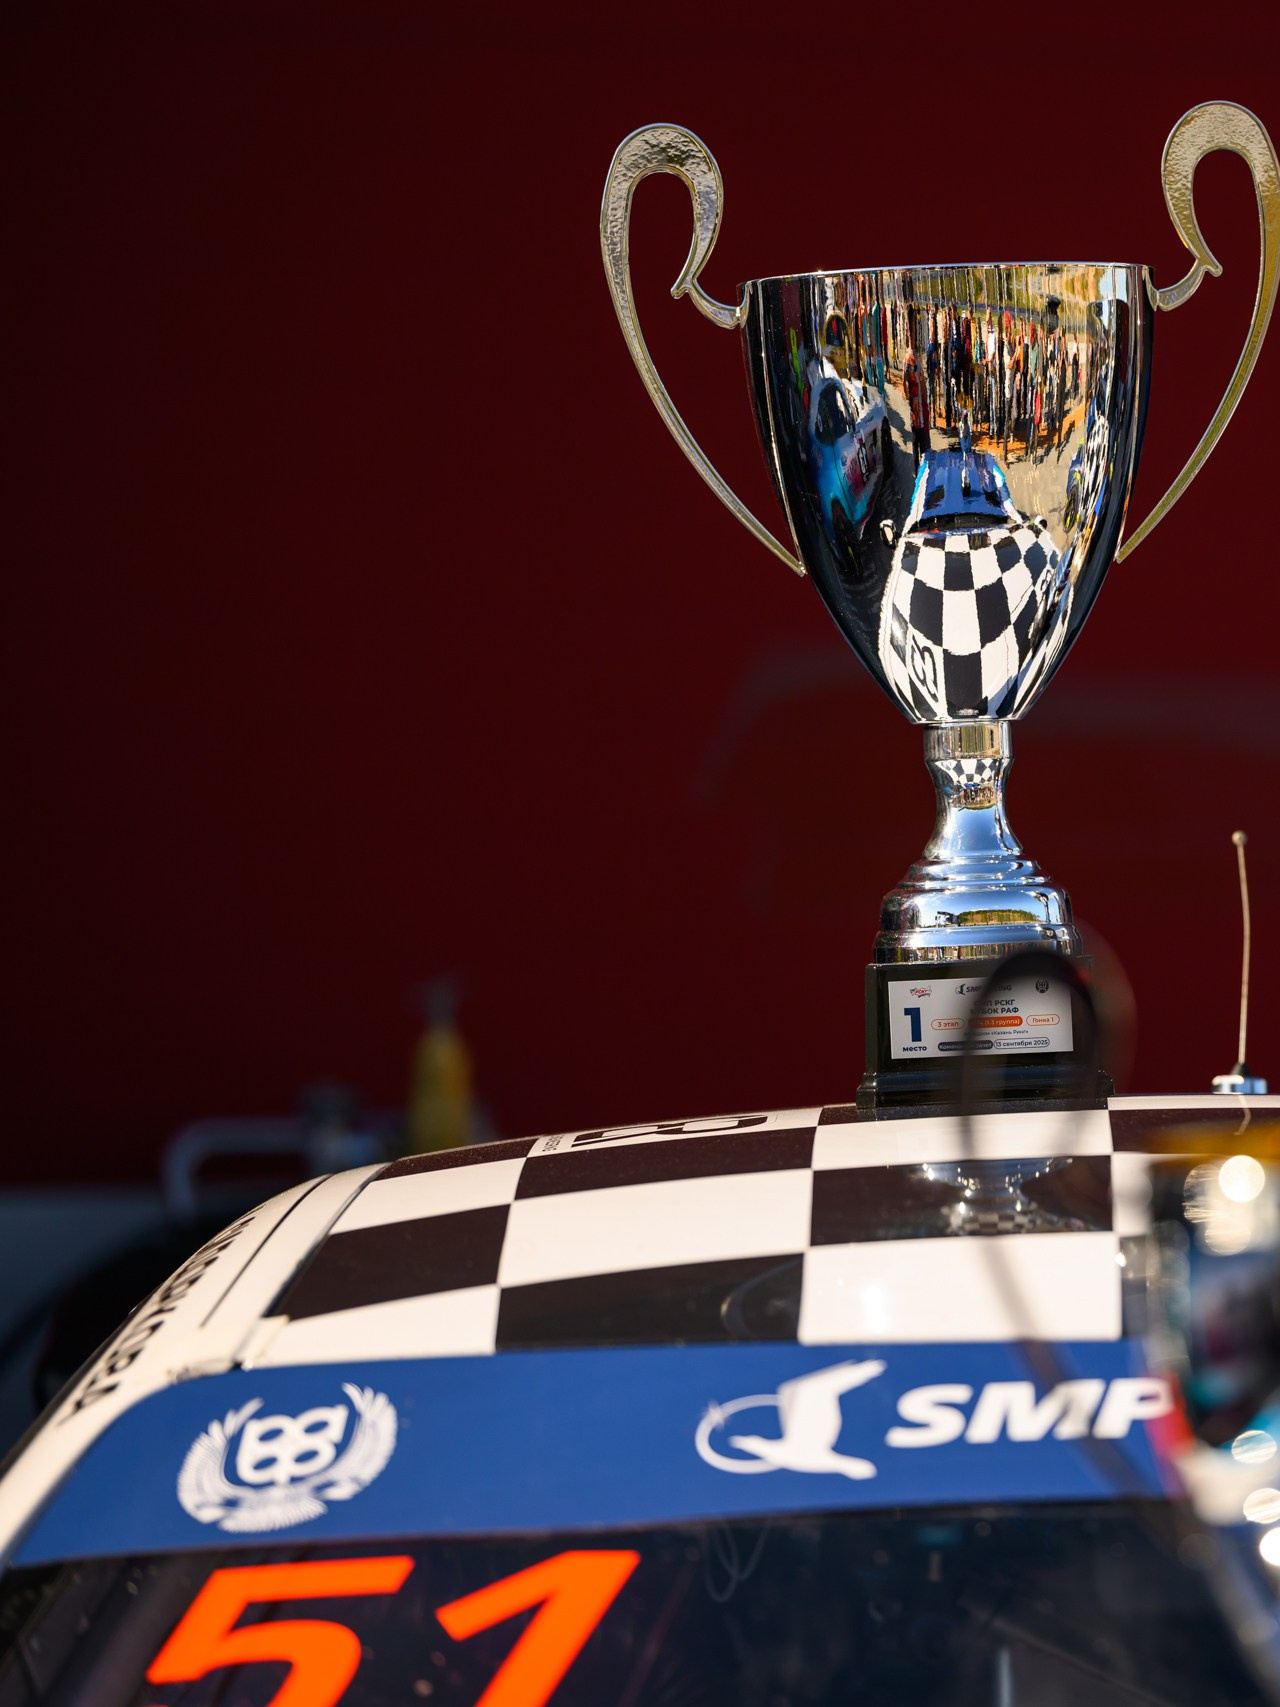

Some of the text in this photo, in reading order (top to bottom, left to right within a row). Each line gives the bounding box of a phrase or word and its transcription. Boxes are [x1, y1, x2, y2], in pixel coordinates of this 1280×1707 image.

[904, 1007, 922, 1042] 1
[1003, 1040, 1032, 1048] сентября
[885, 1377, 1175, 1448] SMP
[145, 1549, 642, 1707] 51
